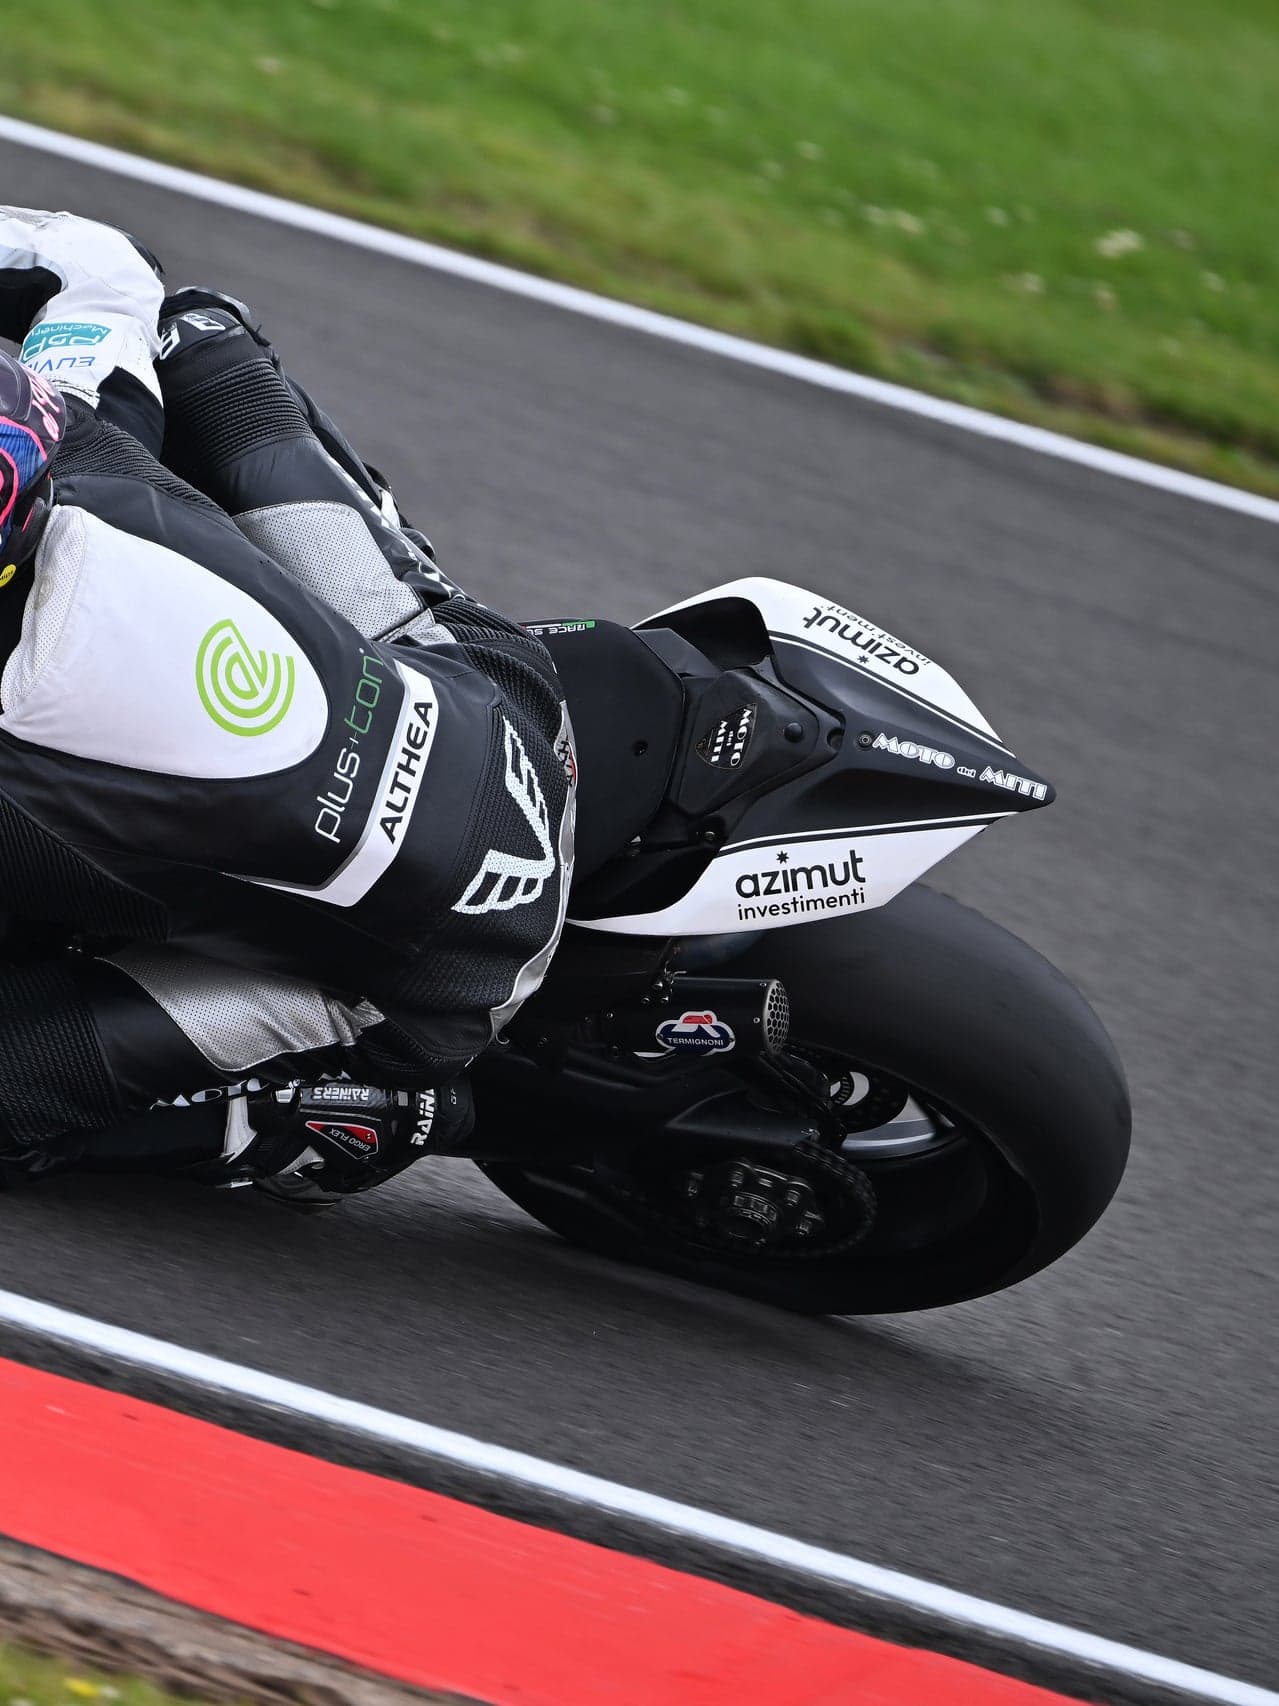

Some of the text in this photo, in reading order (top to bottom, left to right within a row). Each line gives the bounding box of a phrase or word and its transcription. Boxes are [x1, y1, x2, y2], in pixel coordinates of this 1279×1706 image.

[802, 606, 920, 675] azimut
[379, 701, 434, 844] ALTHEA
[872, 732, 955, 770] MOTO
[978, 765, 1049, 801] MITI
[734, 850, 867, 899] azimut
[737, 887, 867, 921] investimenti
[667, 1037, 724, 1046] TERMIGNONI
[329, 1127, 372, 1152] ERGO FLEX
